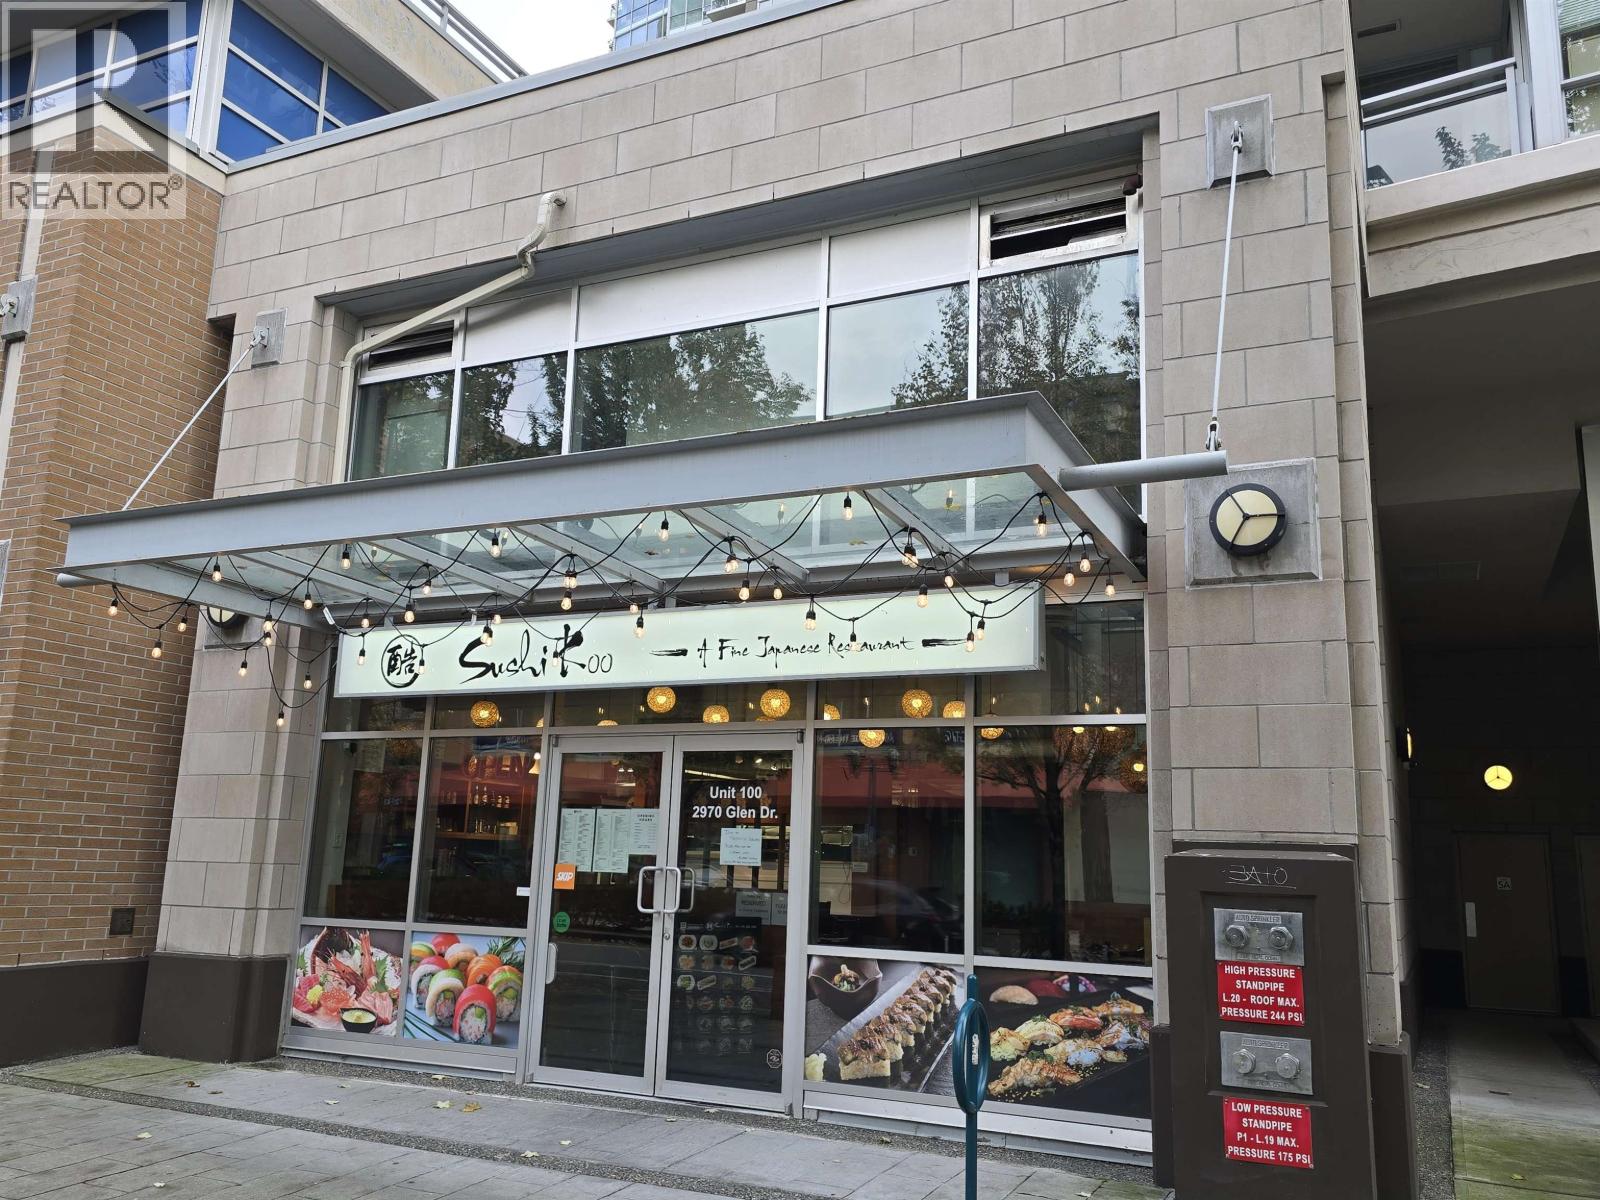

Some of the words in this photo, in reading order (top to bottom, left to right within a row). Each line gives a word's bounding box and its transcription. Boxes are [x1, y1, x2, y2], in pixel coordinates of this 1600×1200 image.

[697, 637, 713, 668] A
[718, 638, 750, 660] Fine
[755, 635, 821, 669] Japanese
[827, 632, 916, 659] Resaurant
[709, 786, 736, 799] Unit
[739, 786, 762, 799] 100
[692, 806, 722, 819] 2970
[725, 806, 756, 819] Glen
[760, 806, 779, 819] Dr.
[1224, 965, 1246, 976] HIGH
[1248, 966, 1296, 979] PRESSURE
[1235, 980, 1285, 992] STANDPIPE
[1223, 995, 1241, 1004] L.20
[1250, 995, 1275, 1006] ROOF
[1277, 997, 1300, 1008] MAX.
[1221, 1006, 1268, 1020] PRESSURE
[1270, 1011, 1286, 1021] 244
[1231, 1103, 1251, 1113] LOW
[1253, 1104, 1303, 1119] PRESSURE
[1242, 1118, 1293, 1132] STANDPIPE
[1237, 1132, 1248, 1142] P1
[1255, 1134, 1275, 1146] L.19
[1276, 1137, 1300, 1148] MAX.
[1227, 1146, 1276, 1160] PRESSURE
[1278, 1151, 1294, 1163] 175
